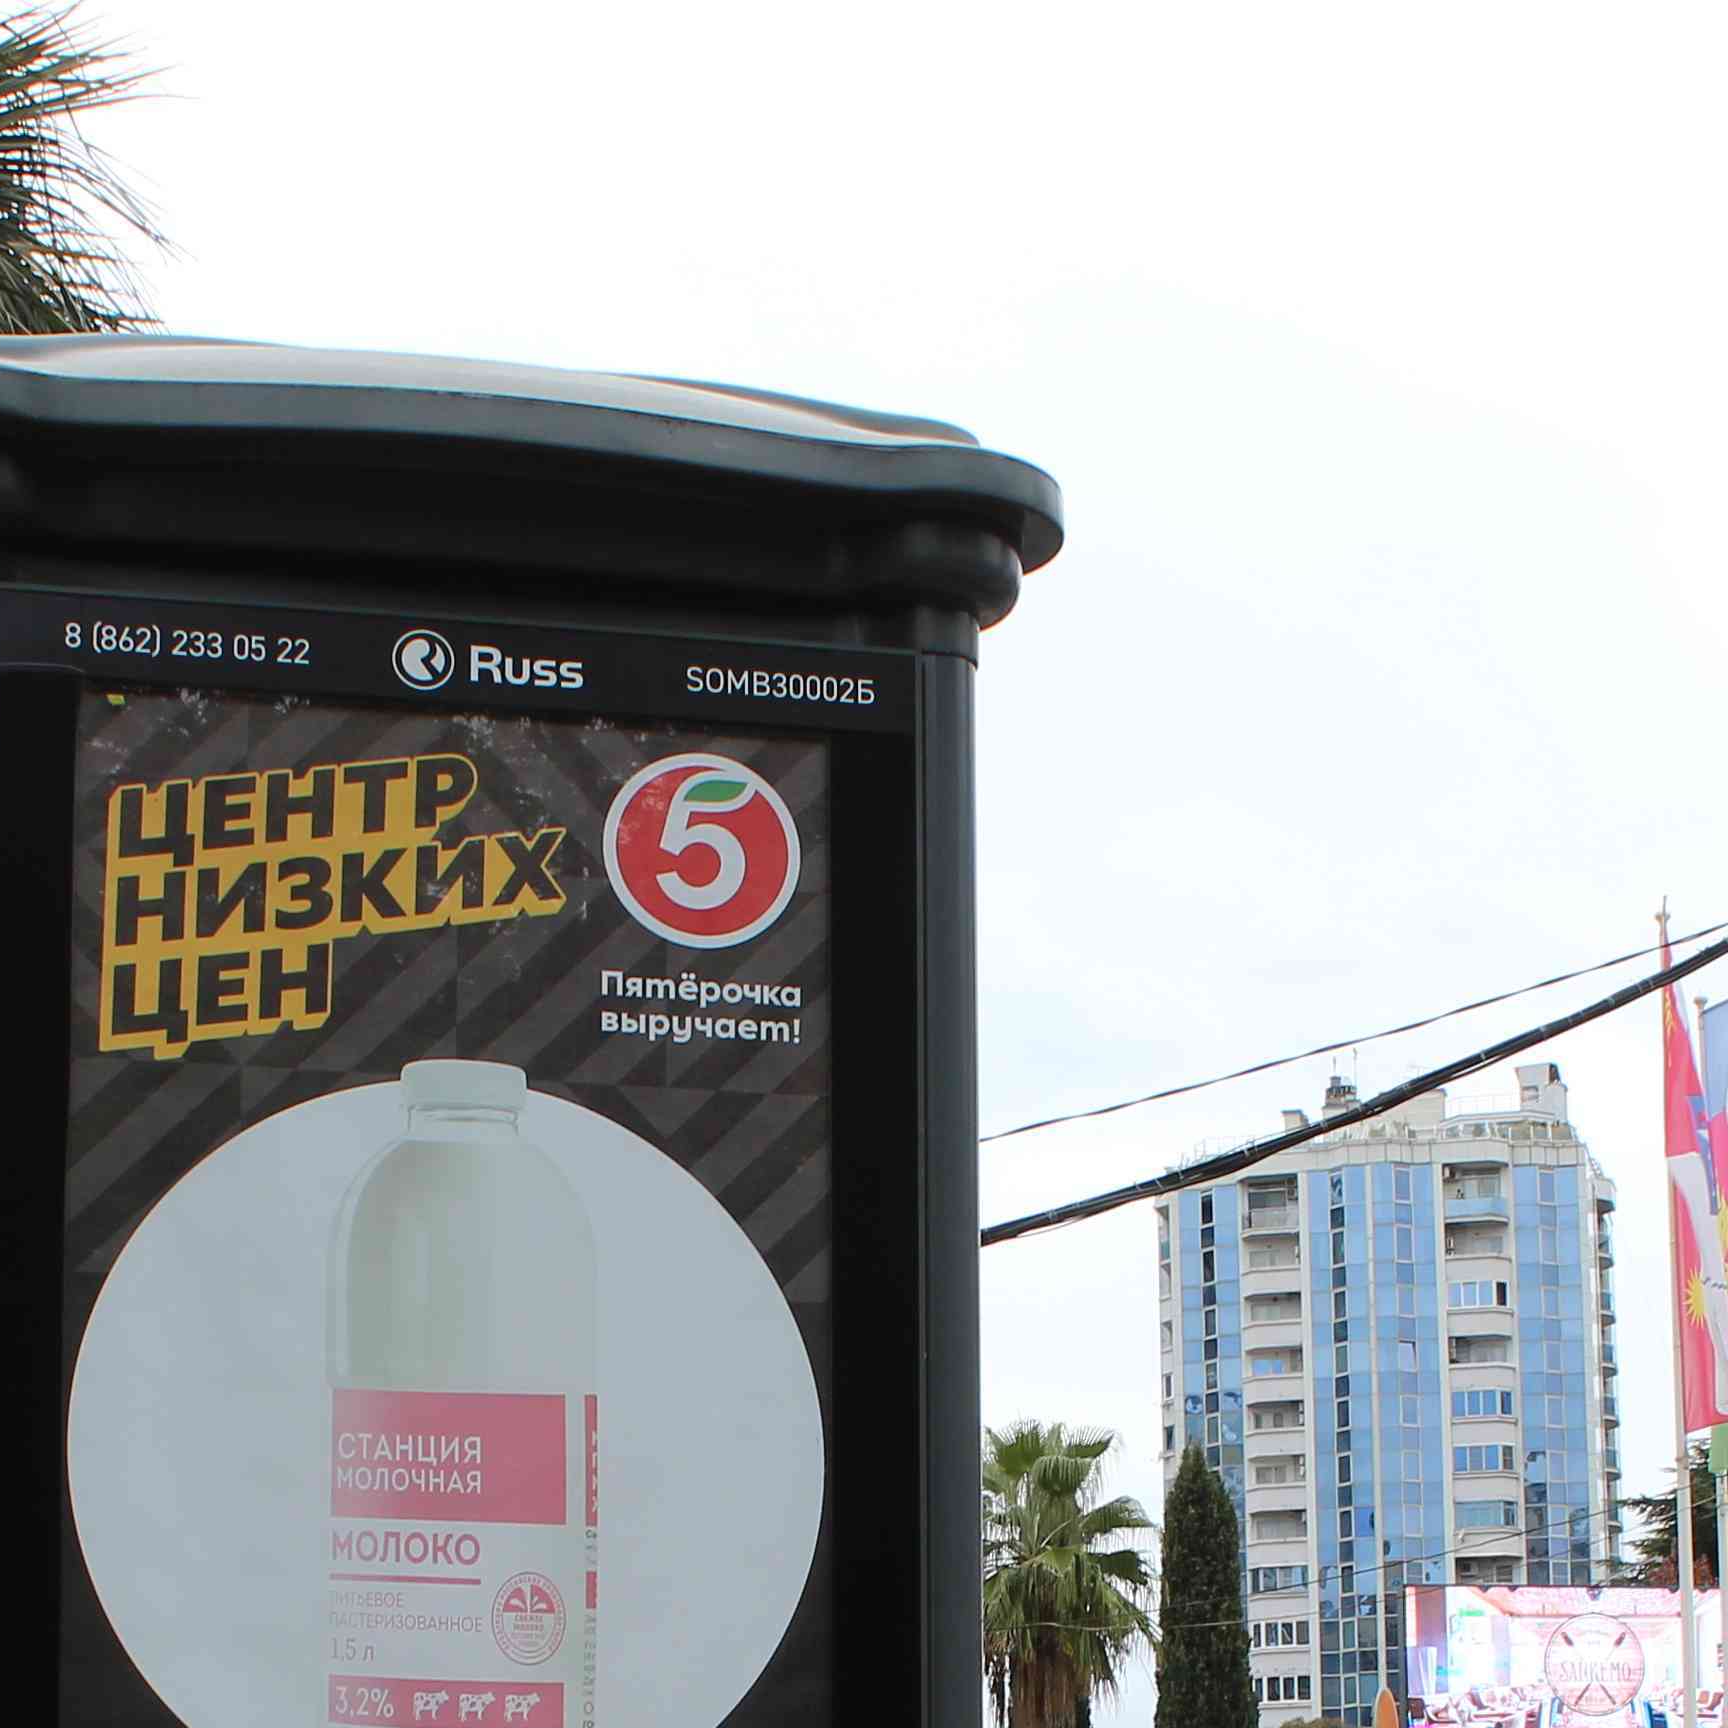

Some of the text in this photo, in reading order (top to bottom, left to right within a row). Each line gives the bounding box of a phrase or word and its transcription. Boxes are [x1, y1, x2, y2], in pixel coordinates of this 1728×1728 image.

[65, 621, 310, 664] 8 (862) 233 05 22
[470, 645, 584, 688] Russ
[117, 754, 478, 868] ЦЕНТР
[115, 828, 567, 948] НИЗКИХ
[111, 942, 332, 1045] ЦЕН
[601, 969, 802, 1009] Пятёрочка
[601, 1011, 802, 1044] выручает!
[337, 1433, 482, 1467] СТАНЦИЯ
[336, 1466, 482, 1494] МОЛОЧНАЯ
[332, 1530, 481, 1566] МОЛОКО
[334, 1686, 394, 1719] 3,2%
